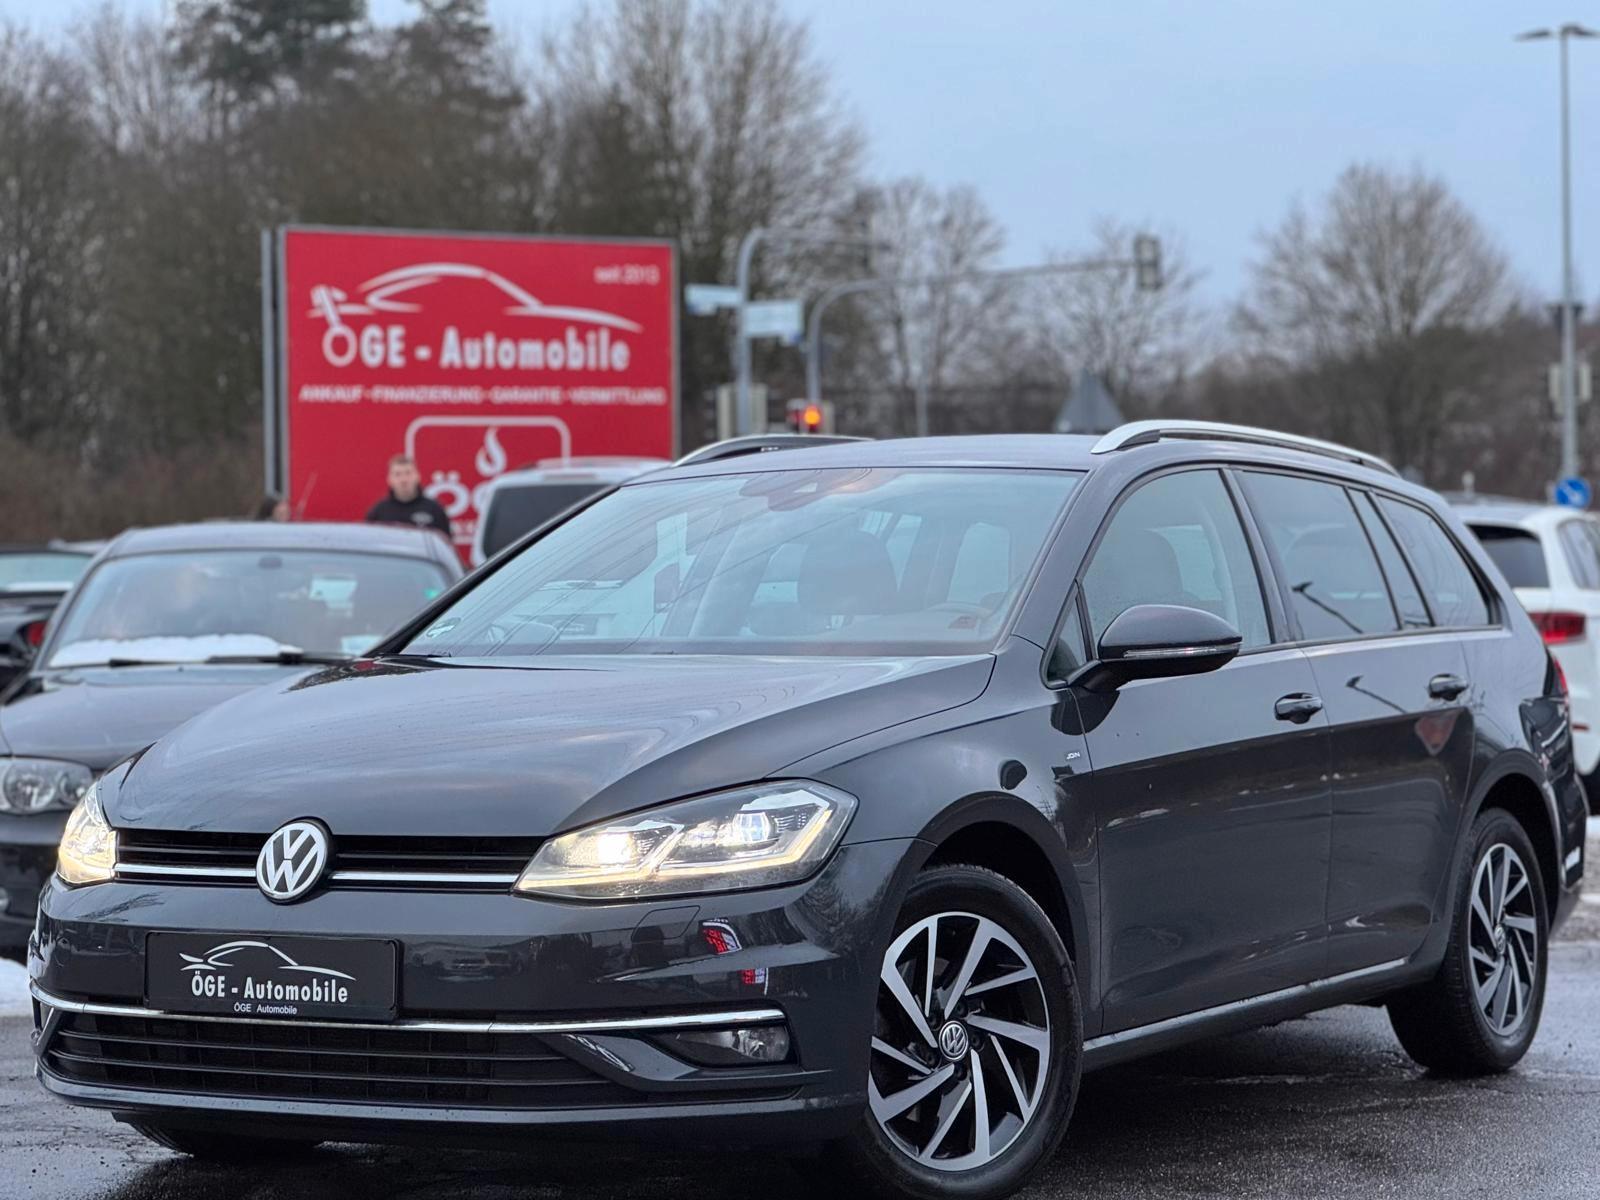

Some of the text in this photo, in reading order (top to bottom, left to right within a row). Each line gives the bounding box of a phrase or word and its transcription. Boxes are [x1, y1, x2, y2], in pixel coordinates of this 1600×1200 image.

[439, 326, 630, 371] Automobile
[260, 825, 323, 897] VW
[192, 970, 226, 997] ÖGE
[244, 976, 348, 1003] Automobile
[256, 1004, 298, 1015] Automobile
